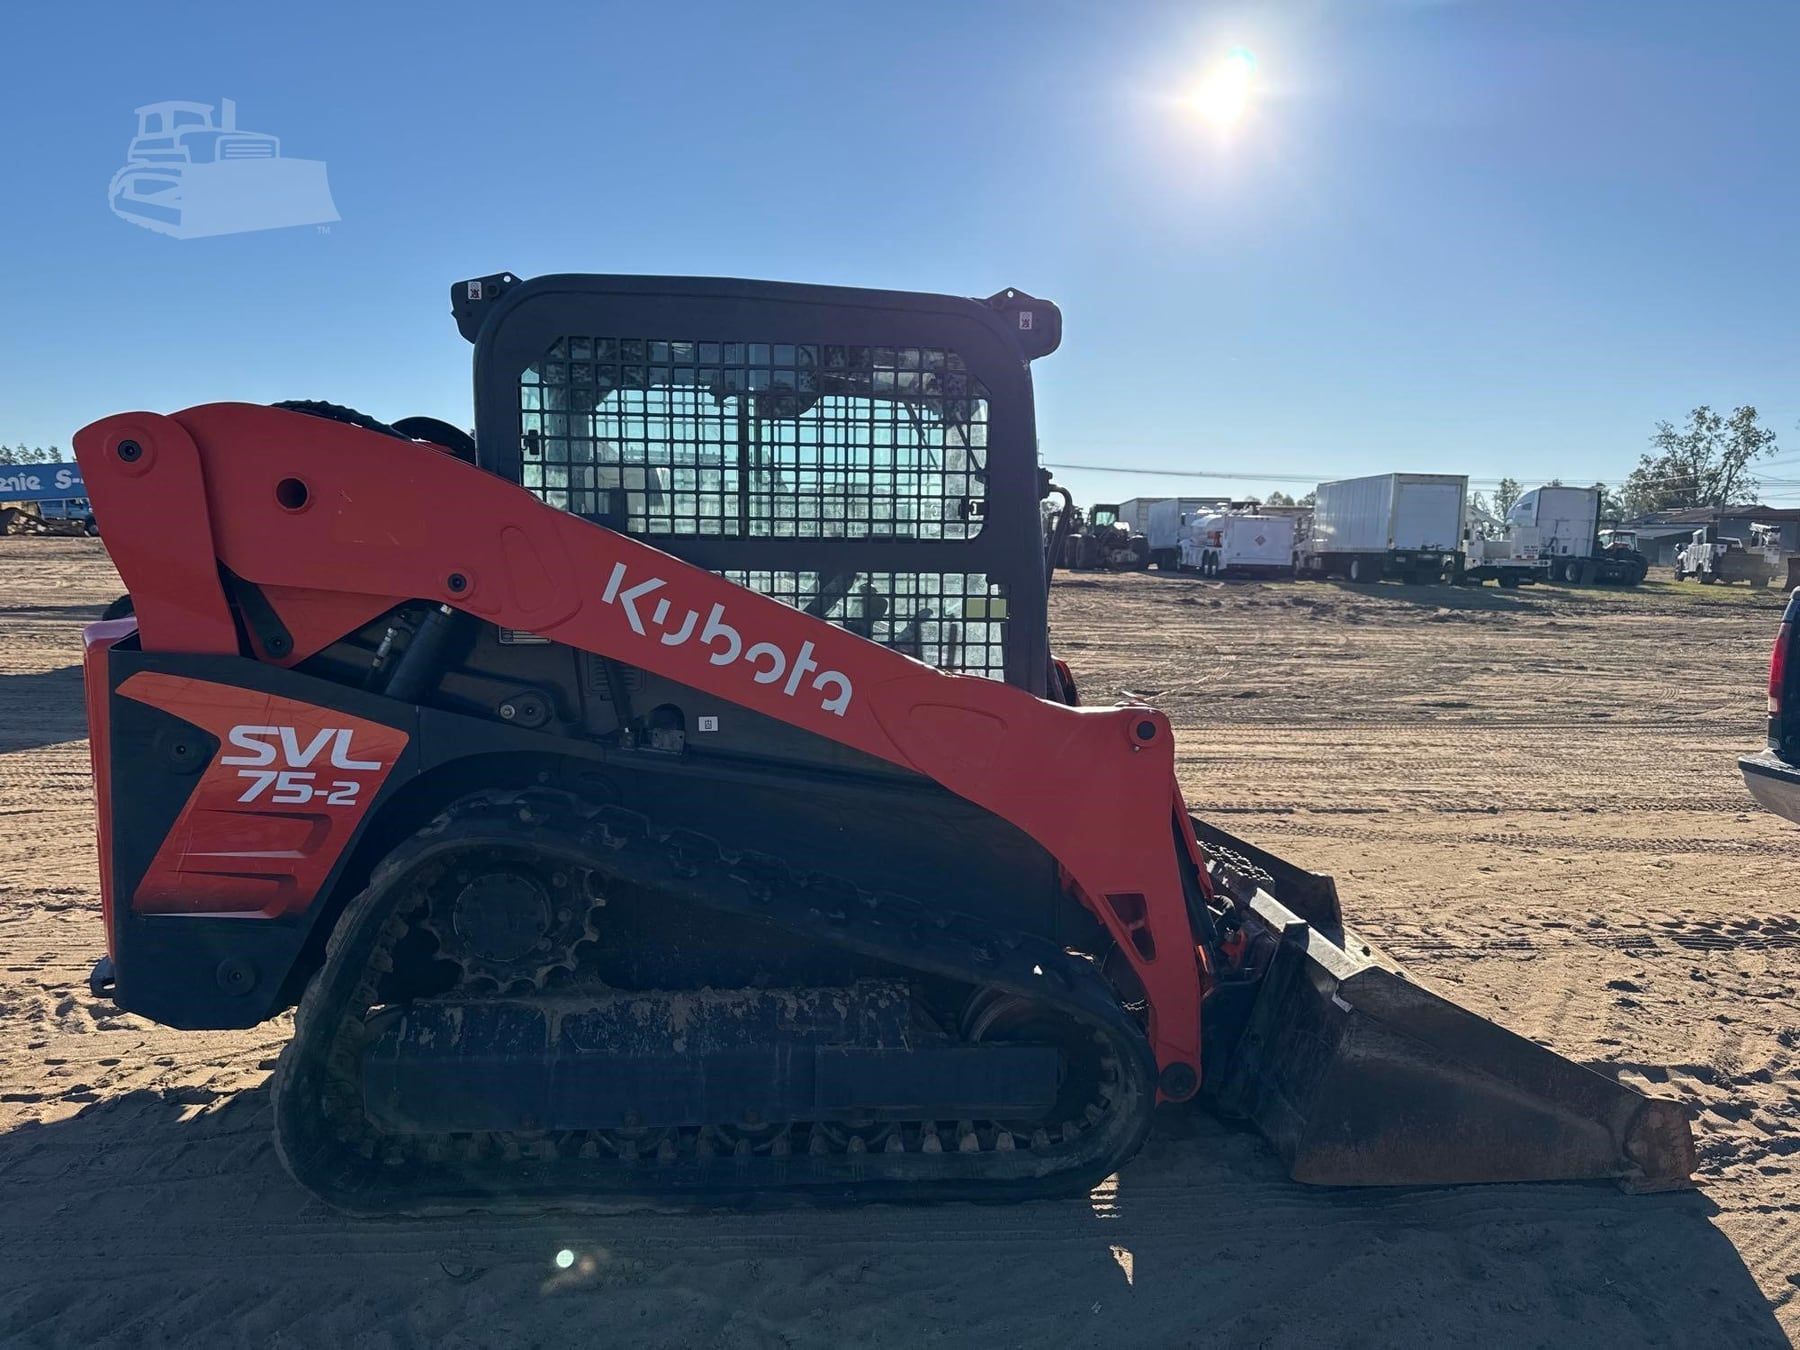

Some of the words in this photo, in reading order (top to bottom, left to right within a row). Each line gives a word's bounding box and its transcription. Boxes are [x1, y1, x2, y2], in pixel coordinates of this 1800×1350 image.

[54, 469, 84, 490] S-
[601, 562, 853, 717] Kubota
[220, 725, 382, 771] SVL
[237, 769, 361, 806] 75-2
